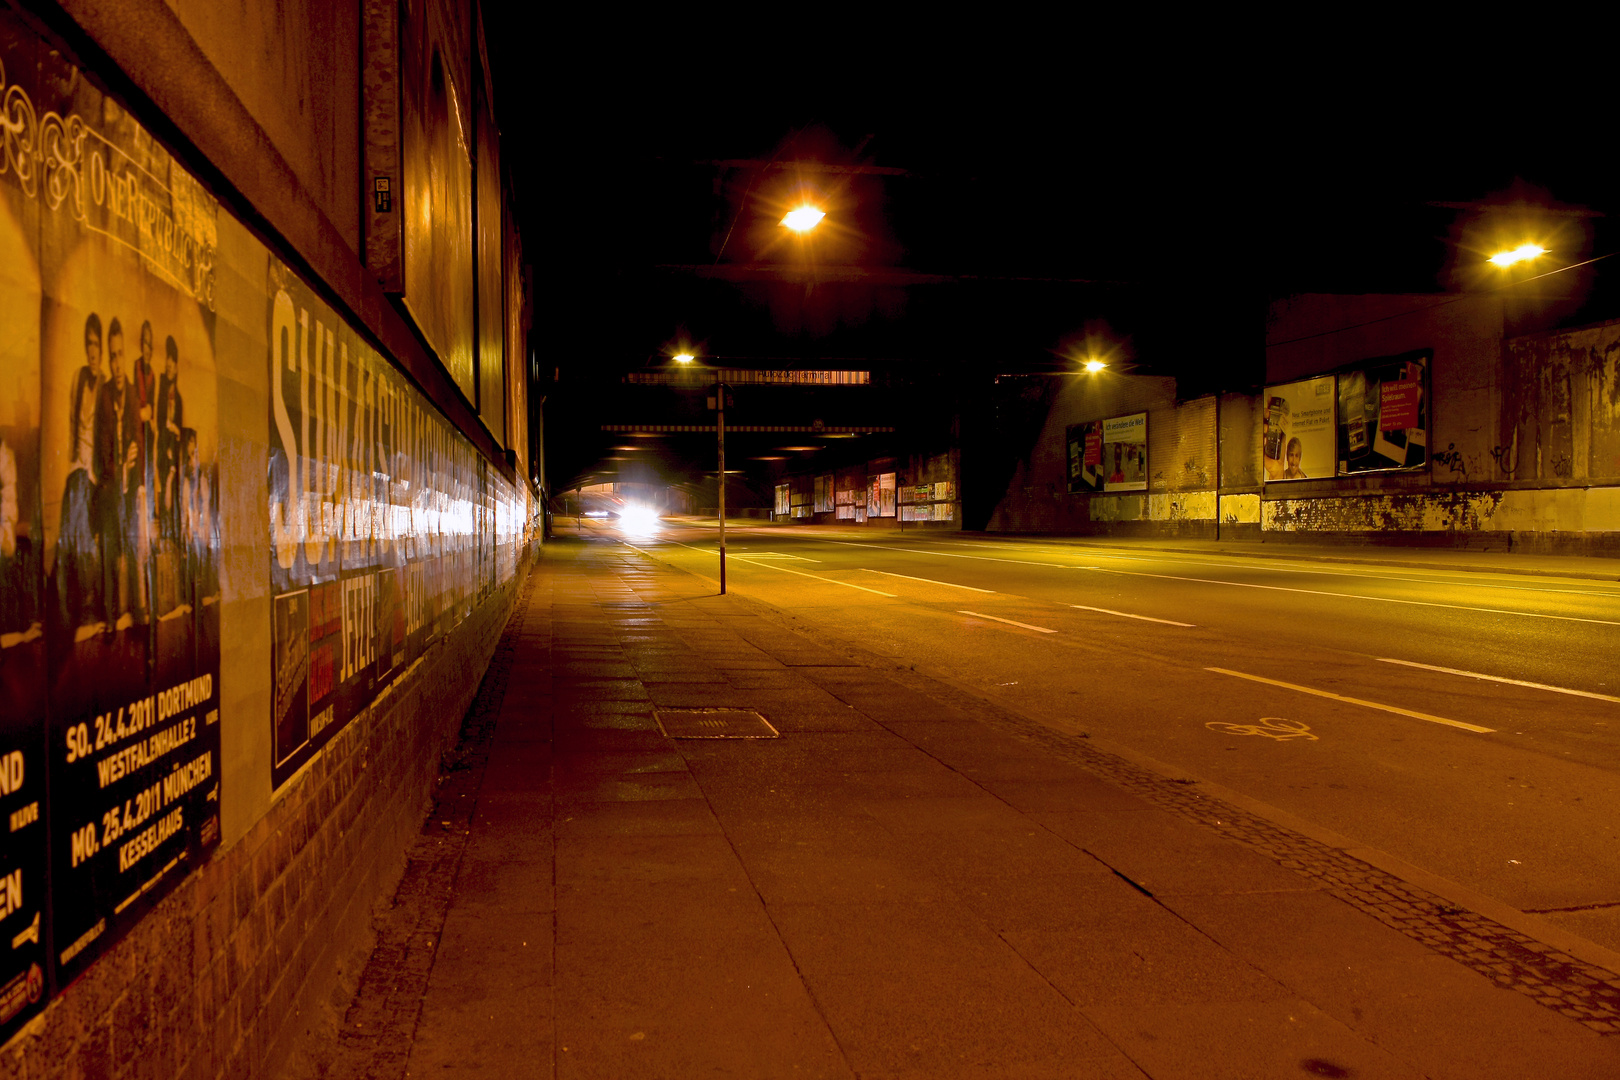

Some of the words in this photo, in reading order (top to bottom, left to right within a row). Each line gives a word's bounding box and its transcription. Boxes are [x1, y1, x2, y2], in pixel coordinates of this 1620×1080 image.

[66, 721, 93, 764] SO.
[95, 694, 155, 751] 24.4.2011
[158, 672, 213, 722] DORTMUND
[97, 718, 190, 789] WESTFALENHALLE
[189, 715, 197, 740] 2
[71, 821, 100, 869] MO.
[102, 781, 161, 848] 25.4.2011
[163, 750, 212, 806] MÜNCHEN
[119, 805, 183, 874] KESSELHAUS
